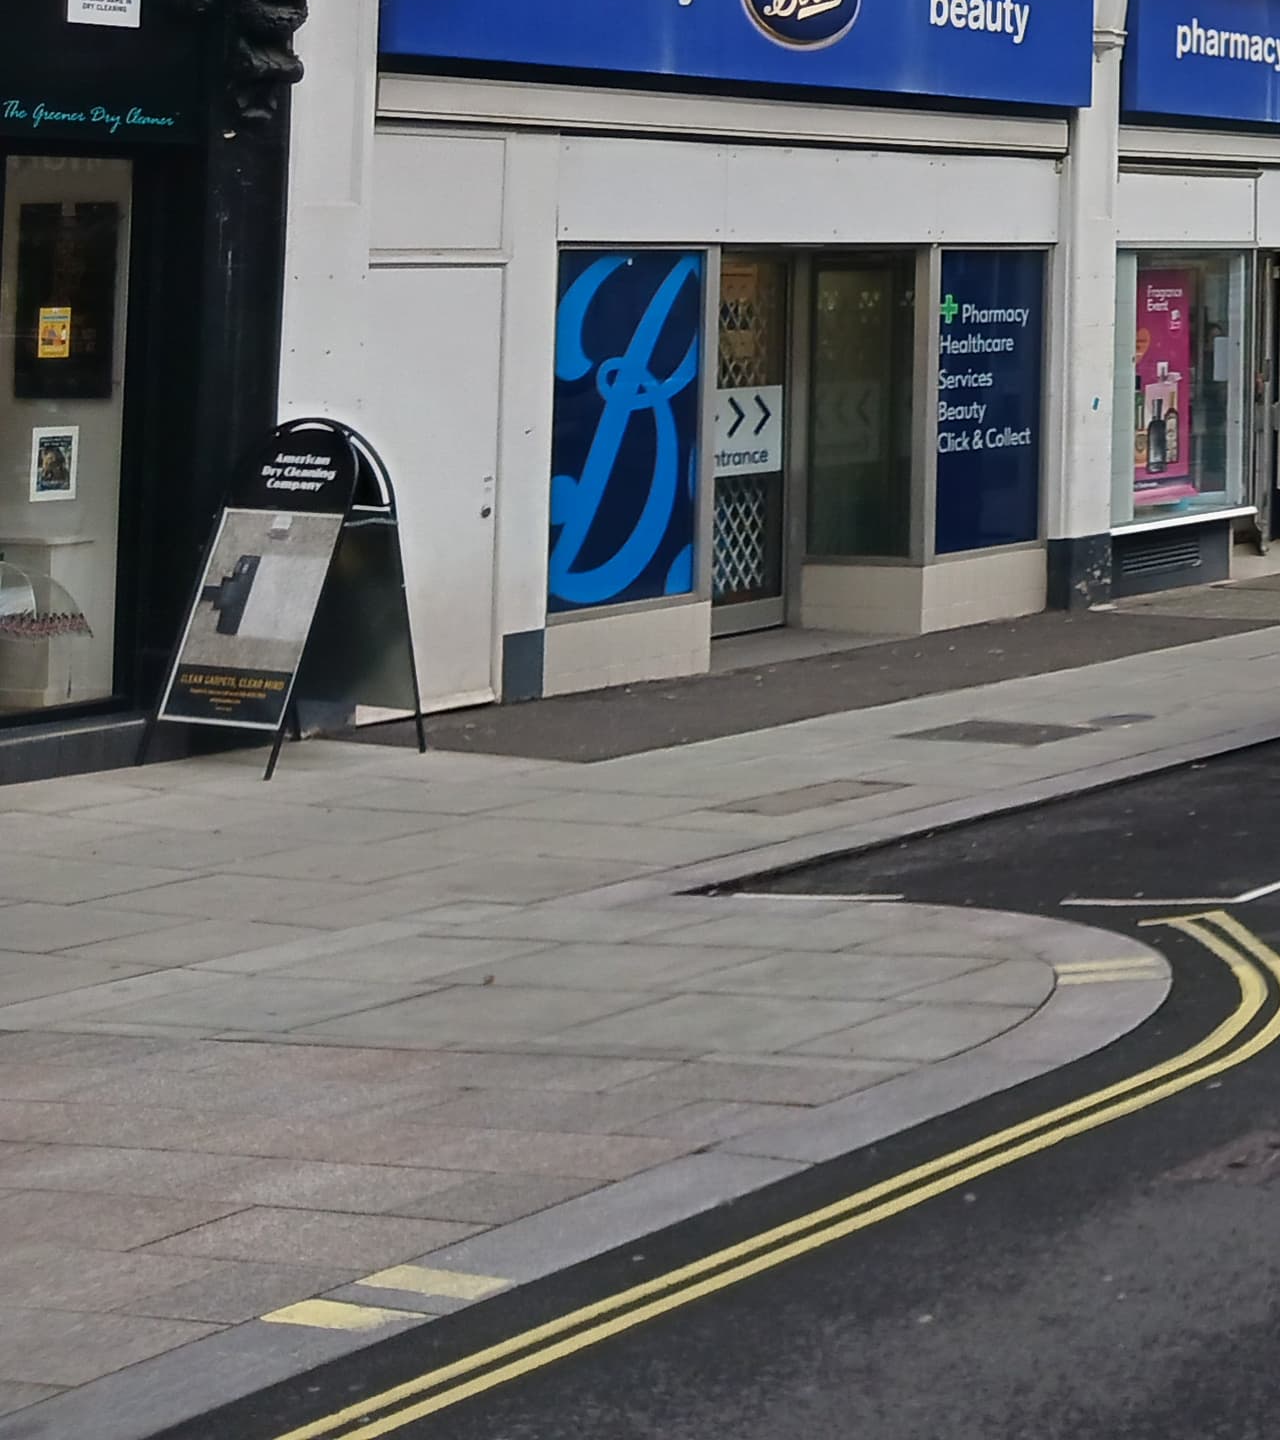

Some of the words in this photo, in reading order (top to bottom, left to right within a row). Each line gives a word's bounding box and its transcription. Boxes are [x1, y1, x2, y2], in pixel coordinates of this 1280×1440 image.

[3, 100, 28, 118] The
[33, 103, 86, 128] Greener
[90, 106, 122, 133] Dry
[962, 303, 1029, 327] Pharmacy
[940, 333, 1014, 354] Healthcare
[938, 368, 993, 389] Services
[938, 401, 987, 424] Beauty
[937, 430, 970, 453] Click
[972, 429, 984, 450] &
[985, 427, 1031, 448] Collect
[275, 453, 331, 465] American
[714, 449, 769, 467] ntrance
[261, 465, 282, 477] Dry
[284, 466, 337, 480] Cleaning
[266, 478, 324, 492] Company
